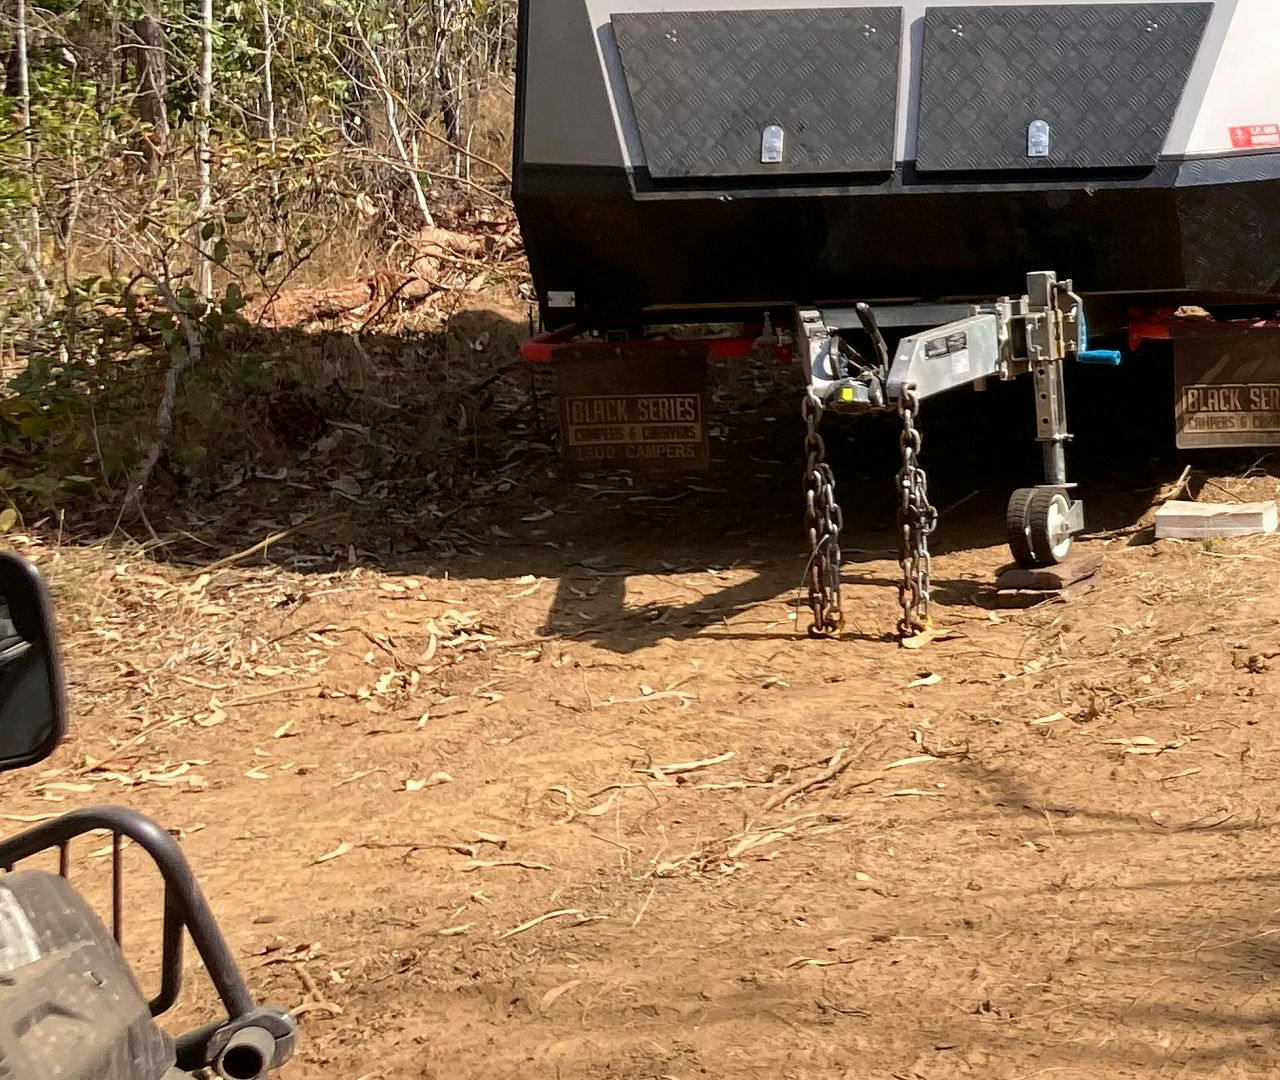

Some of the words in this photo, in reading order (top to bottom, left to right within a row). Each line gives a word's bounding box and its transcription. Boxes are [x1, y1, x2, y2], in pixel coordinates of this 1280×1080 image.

[1187, 388, 1242, 412] BLACK
[572, 400, 628, 423] BLACK
[638, 398, 695, 422] SERIES
[1188, 415, 1235, 430] CAMPERS
[625, 444, 696, 458] CAMPERS
